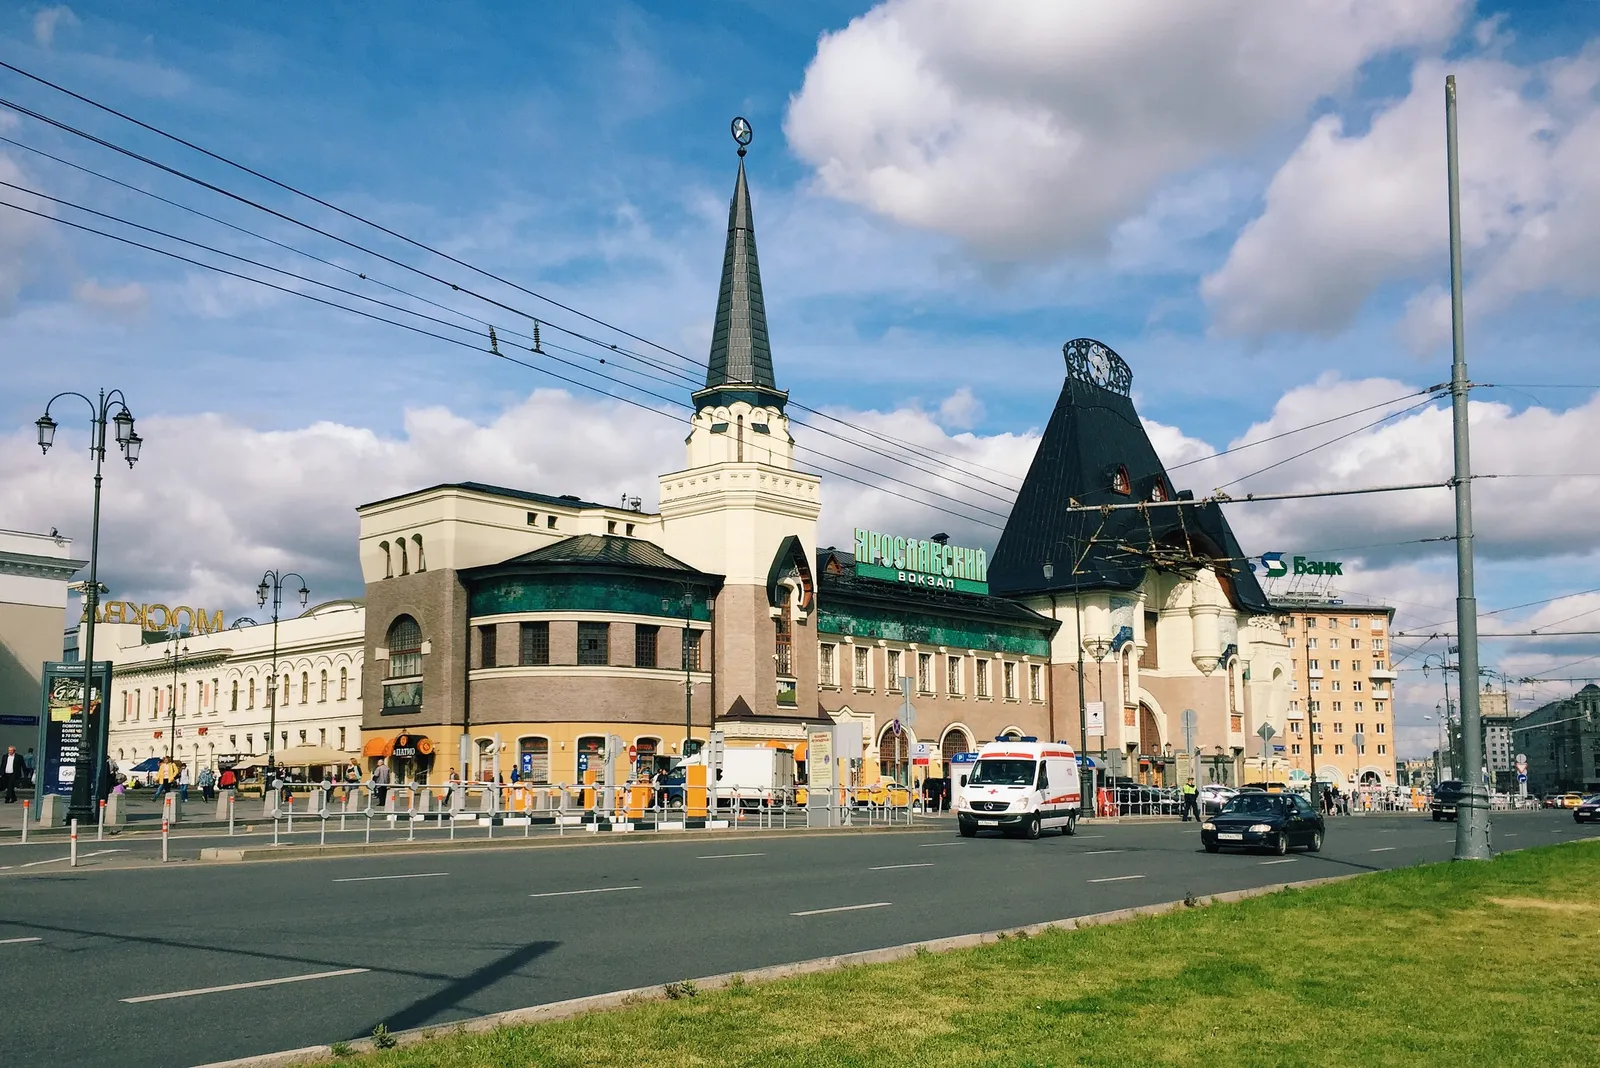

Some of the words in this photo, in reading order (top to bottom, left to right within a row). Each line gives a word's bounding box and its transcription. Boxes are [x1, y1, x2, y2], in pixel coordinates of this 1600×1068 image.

[854, 527, 987, 582] ЯРОСЛАВСКИЙ
[1293, 556, 1343, 576] Банк
[898, 571, 955, 589] ВОКЗАЛ
[395, 747, 416, 757] ПАТИО
